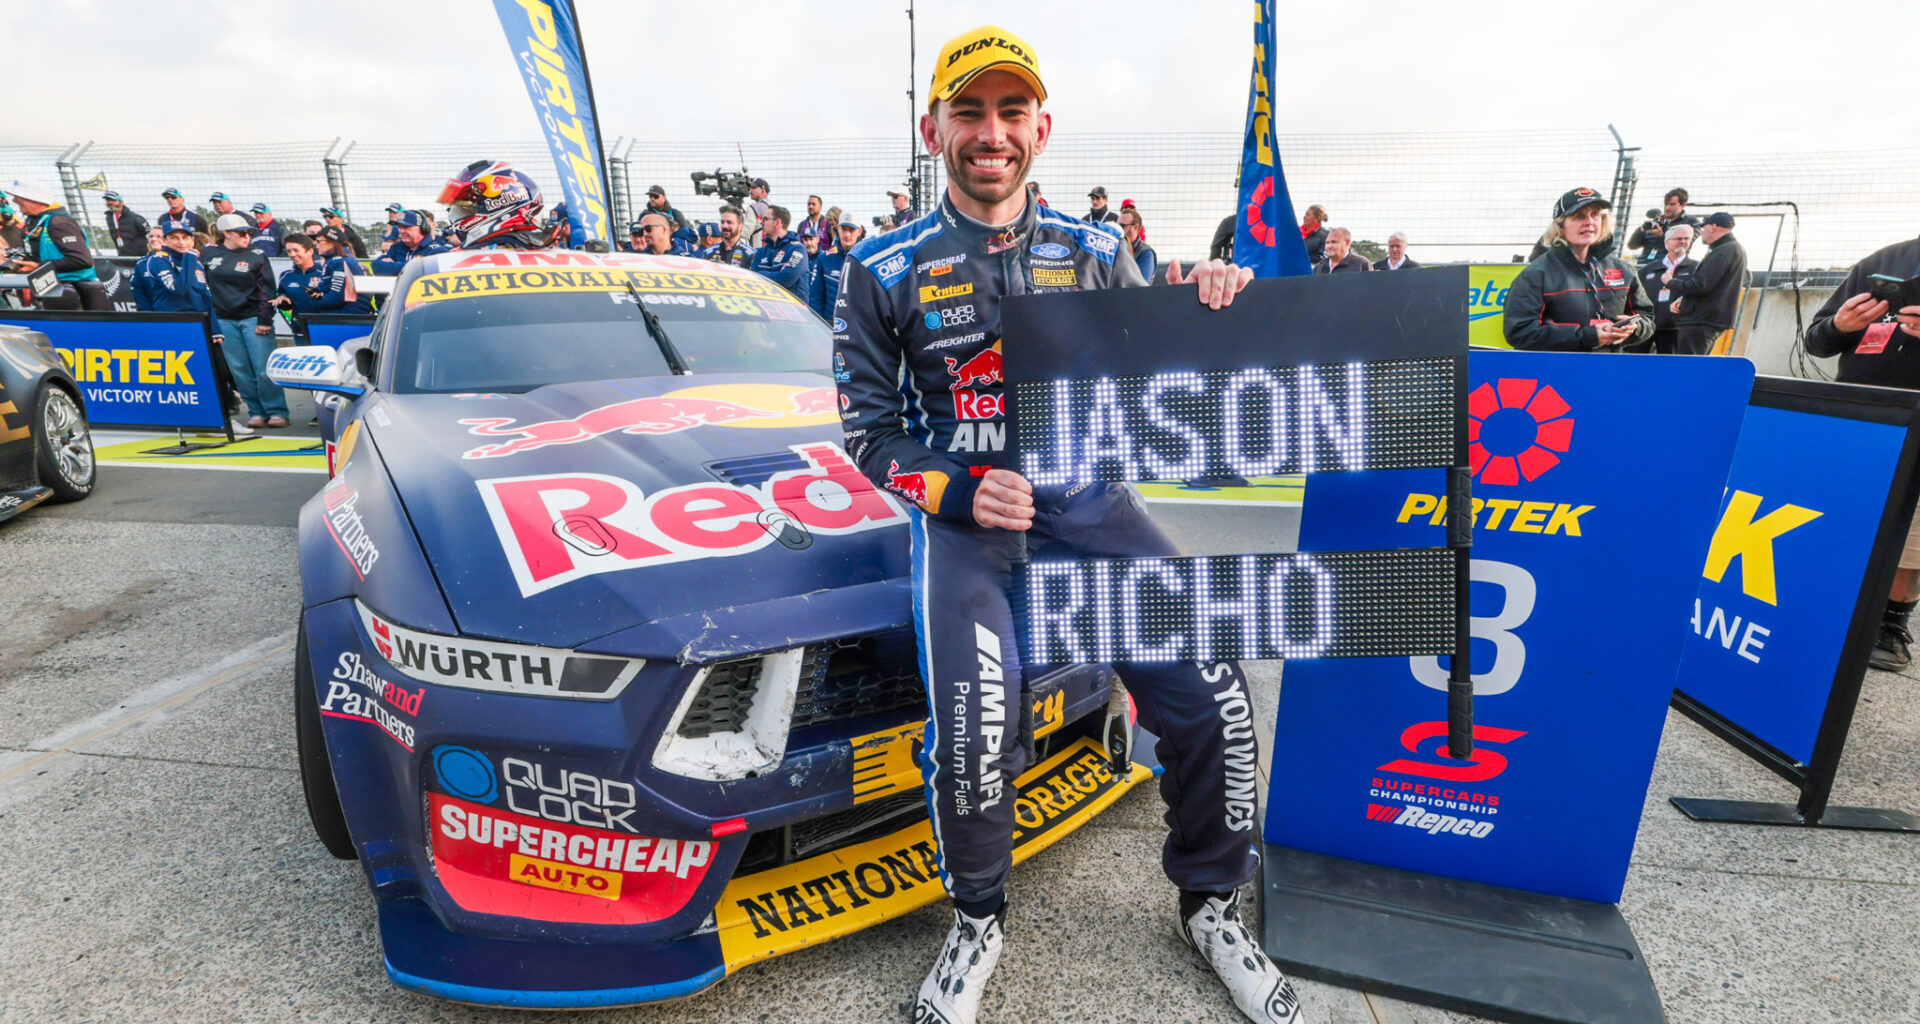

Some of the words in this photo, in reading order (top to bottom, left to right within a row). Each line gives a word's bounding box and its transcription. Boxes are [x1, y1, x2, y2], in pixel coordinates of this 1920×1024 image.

[947, 37, 1033, 68] DUNLOP
[520, 51, 570, 168] VICTORY
[485, 193, 508, 211] Red
[508, 188, 530, 204] Bull
[1087, 235, 1116, 253] OMP
[877, 255, 907, 277] OMP
[916, 253, 967, 274] SUPERCHEAP
[932, 265, 951, 275] AUTO
[1033, 268, 1075, 277] NATIONAL
[1035, 276, 1075, 285] STORAGE
[420, 270, 629, 298] NATIONAL
[631, 271, 784, 300] STORAGE
[709, 294, 761, 316] 88
[941, 304, 974, 318] QUAD
[942, 313, 976, 327] LOCK
[931, 332, 985, 350] FREIGHTER
[268, 352, 337, 377] Thrifty
[88, 388, 152, 404] VICTORY
[159, 390, 200, 405] LANE
[1024, 362, 1366, 487] JASON
[490, 443, 901, 586] Red
[328, 491, 380, 576] Partners
[1029, 552, 1334, 666] RICHO
[1690, 598, 1771, 664] ANE
[395, 634, 553, 687] WÜRTH
[320, 679, 415, 749] Partners
[1213, 679, 1254, 741] YOU
[953, 681, 971, 775] Premium
[502, 757, 637, 808] QUAD
[955, 778, 973, 816] Fuels
[1012, 752, 1113, 840] ORAGE
[1224, 741, 1256, 832] WINGS
[1371, 777, 1501, 806] SUPERCARS
[505, 785, 640, 834] LOCK
[1369, 788, 1498, 815] CHAMPIONSHIP
[1393, 804, 1495, 839] Repco
[440, 804, 711, 880] SUPERCHEAP
[520, 863, 610, 892] AUTO
[737, 837, 941, 939] NATIONA
[1271, 981, 1297, 1018] OMP
